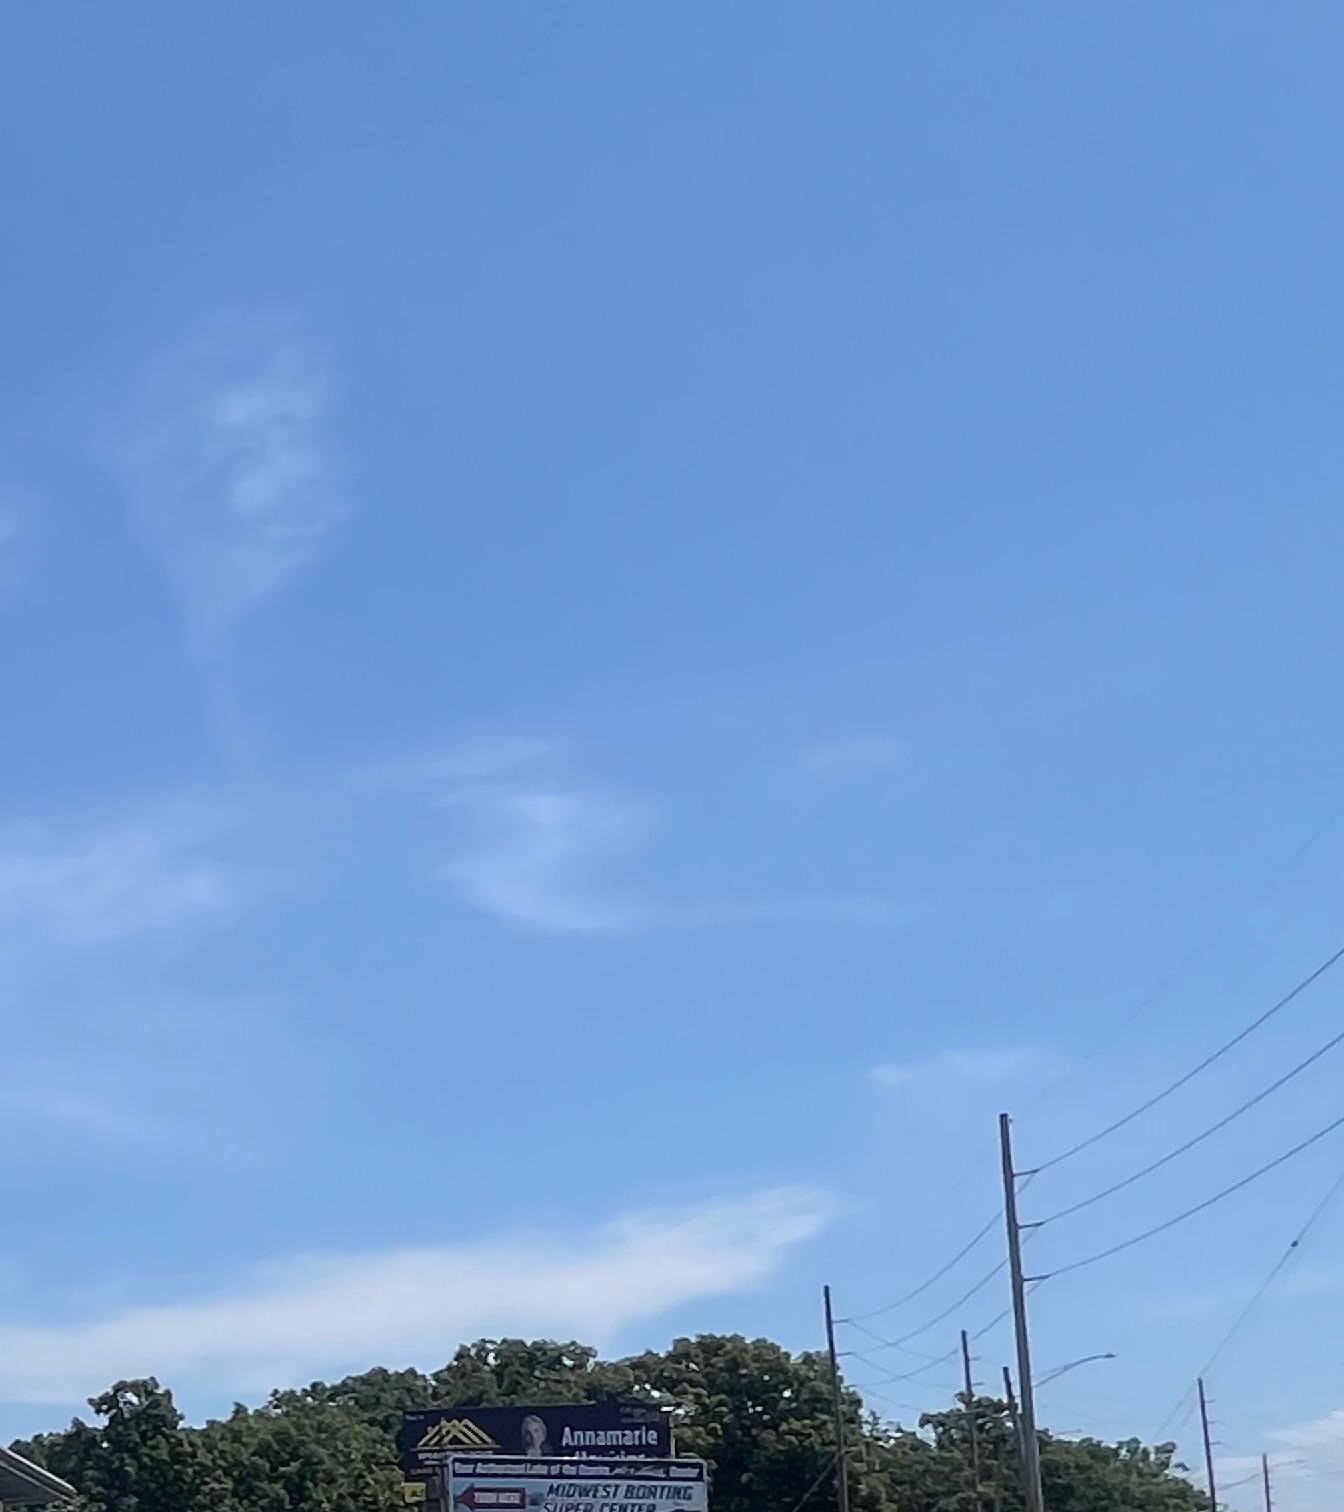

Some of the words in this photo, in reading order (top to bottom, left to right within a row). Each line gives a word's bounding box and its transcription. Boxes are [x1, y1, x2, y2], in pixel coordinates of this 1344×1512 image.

[562, 1425, 658, 1447] Annamarie
[546, 1483, 620, 1499] MIDWEST
[624, 1485, 693, 1501] BOATING
